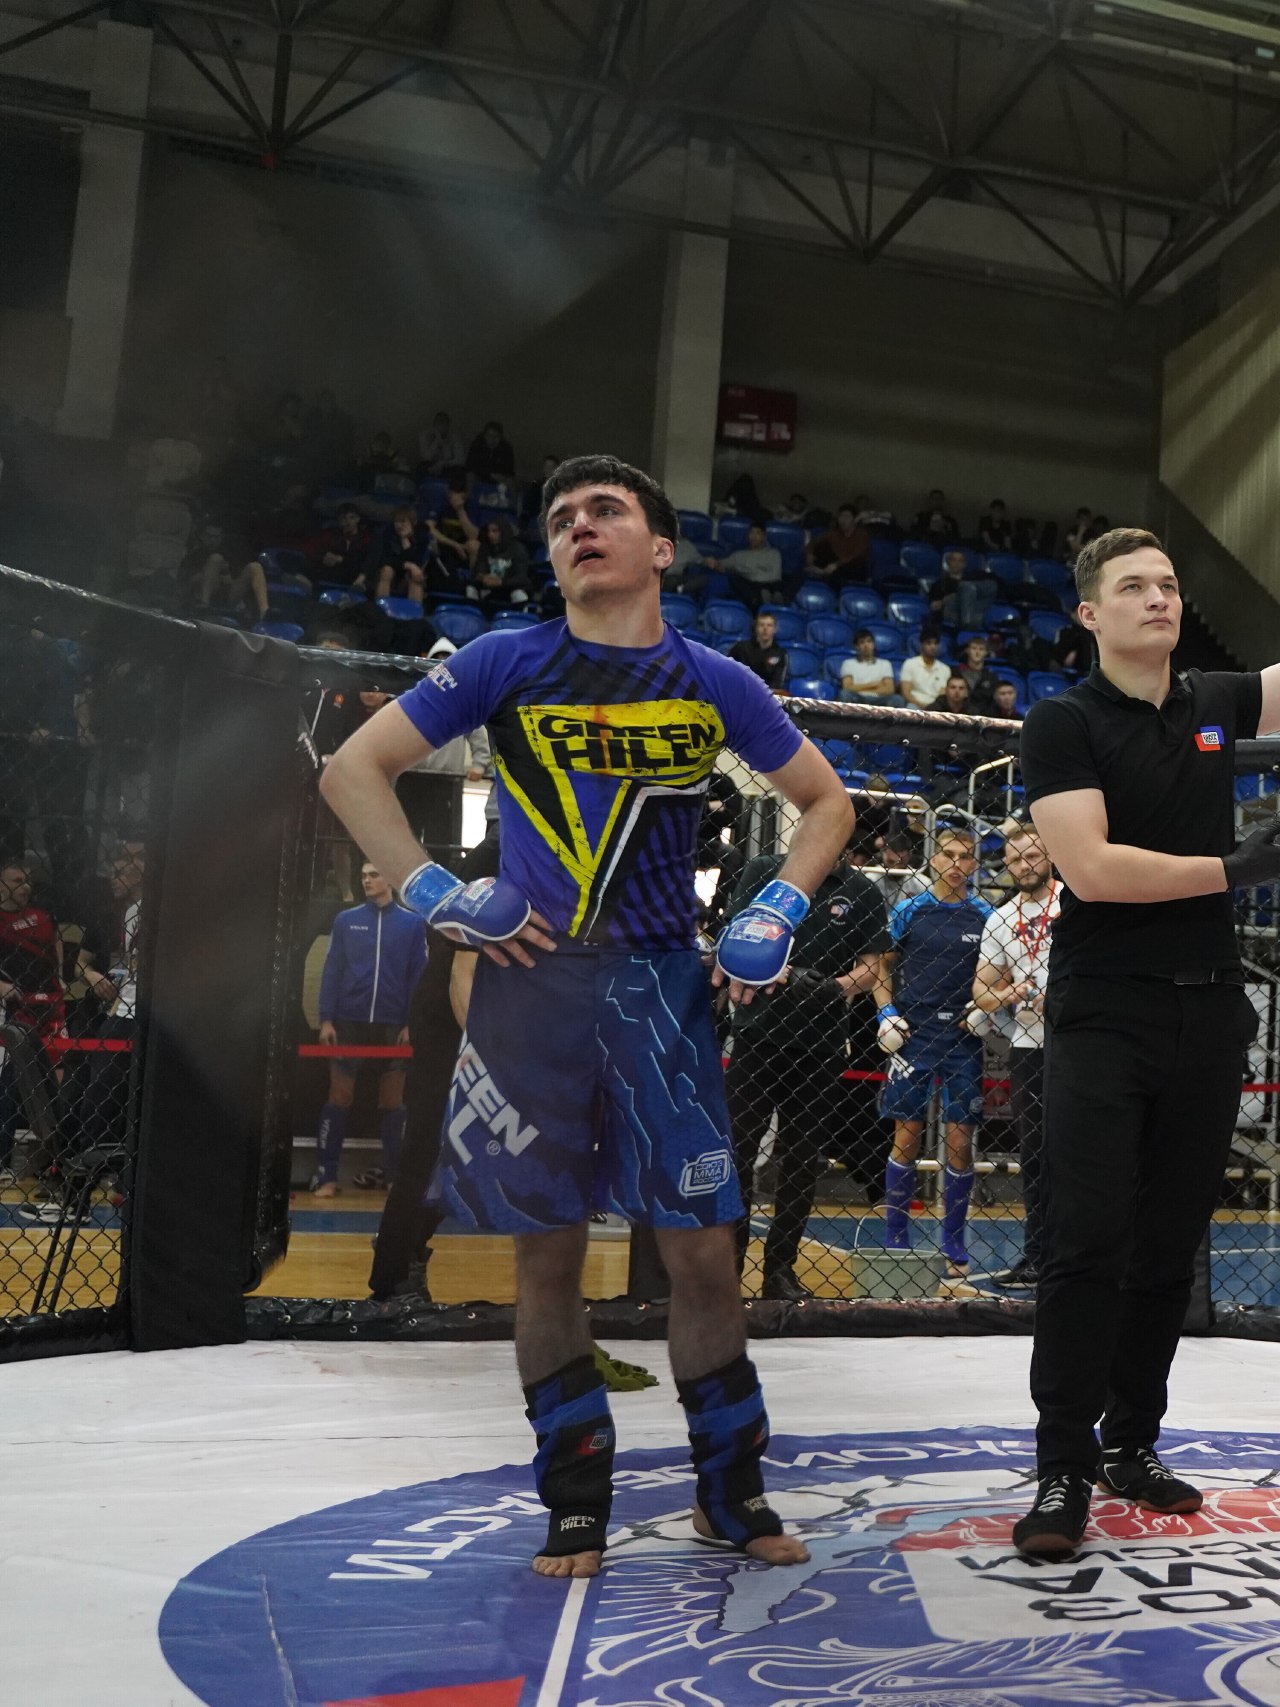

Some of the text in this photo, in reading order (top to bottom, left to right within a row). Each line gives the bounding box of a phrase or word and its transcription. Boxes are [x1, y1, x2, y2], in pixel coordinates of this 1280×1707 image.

[538, 714, 717, 749] GREEN
[550, 738, 703, 770] HILL
[560, 1515, 595, 1525] GREEN
[560, 1520, 590, 1532] HILL
